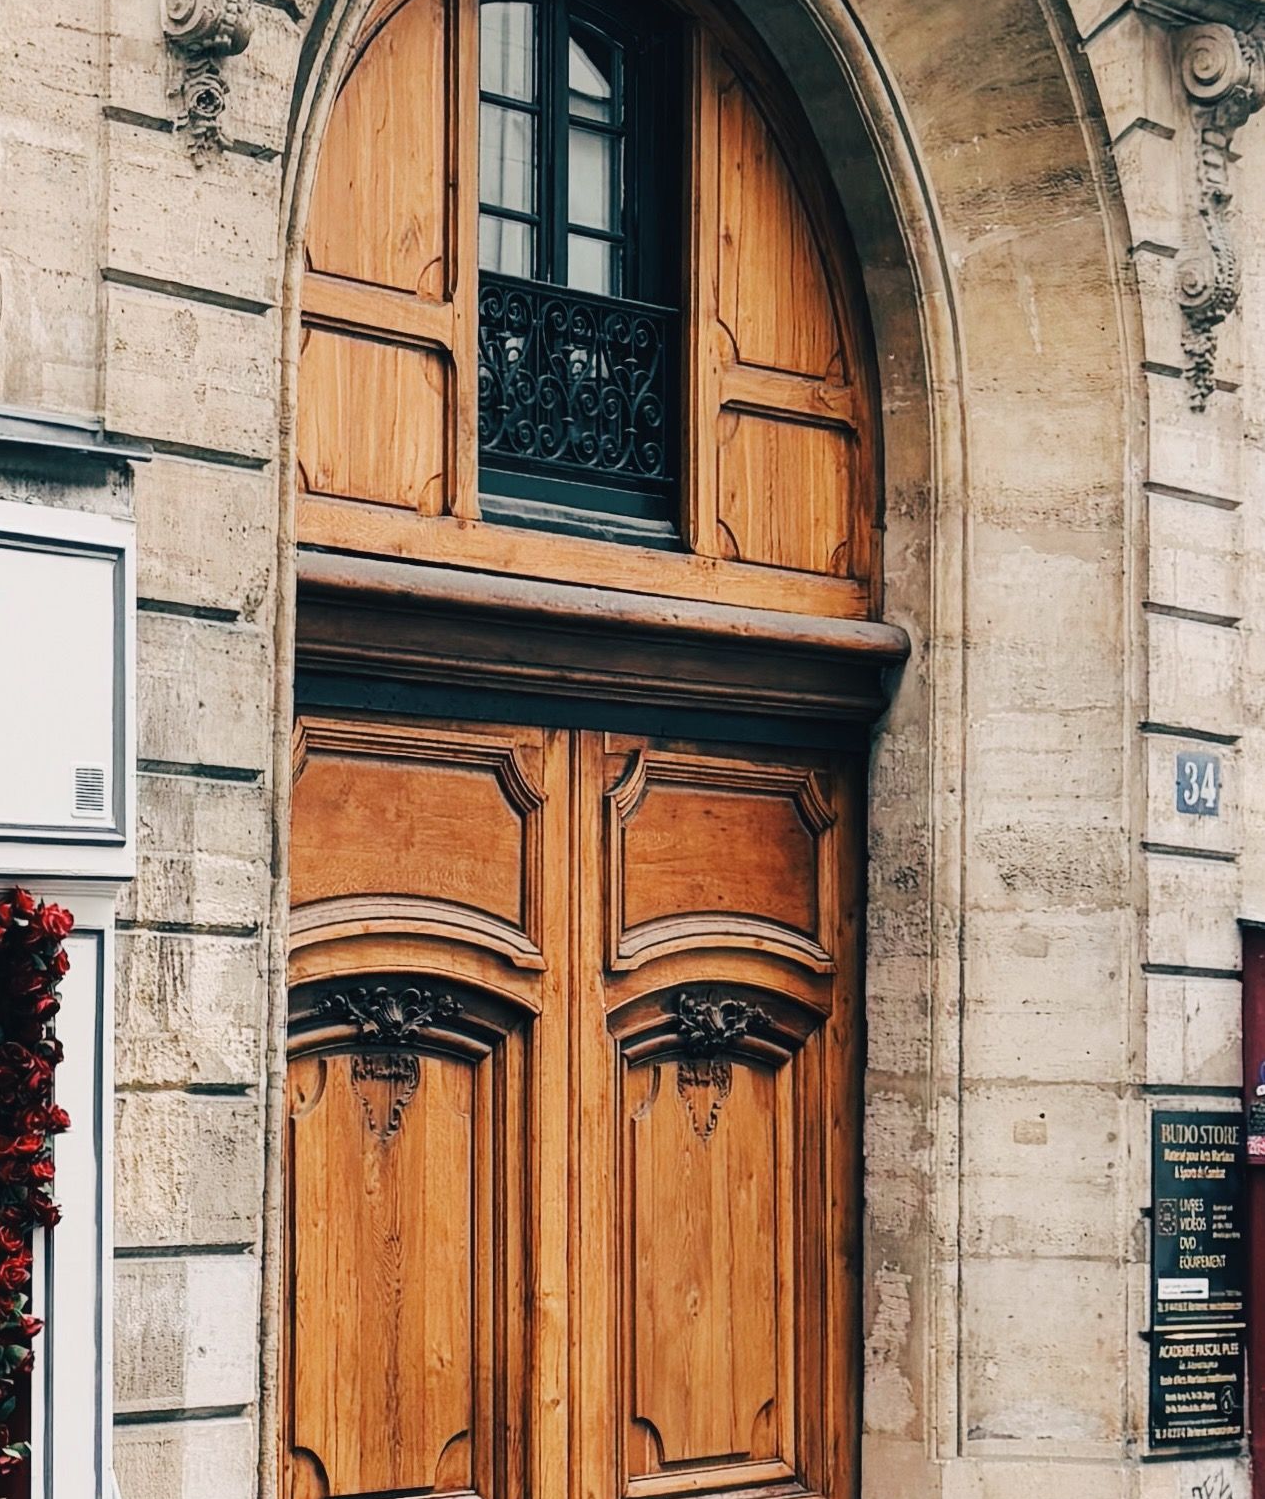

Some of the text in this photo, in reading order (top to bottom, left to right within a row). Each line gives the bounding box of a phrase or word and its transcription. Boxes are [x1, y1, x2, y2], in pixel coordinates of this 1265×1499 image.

[1184, 762, 1216, 808] 34
[1161, 1123, 1198, 1144] BUDO
[1199, 1125, 1240, 1145] STORE
[1179, 1236, 1197, 1250] DVD
